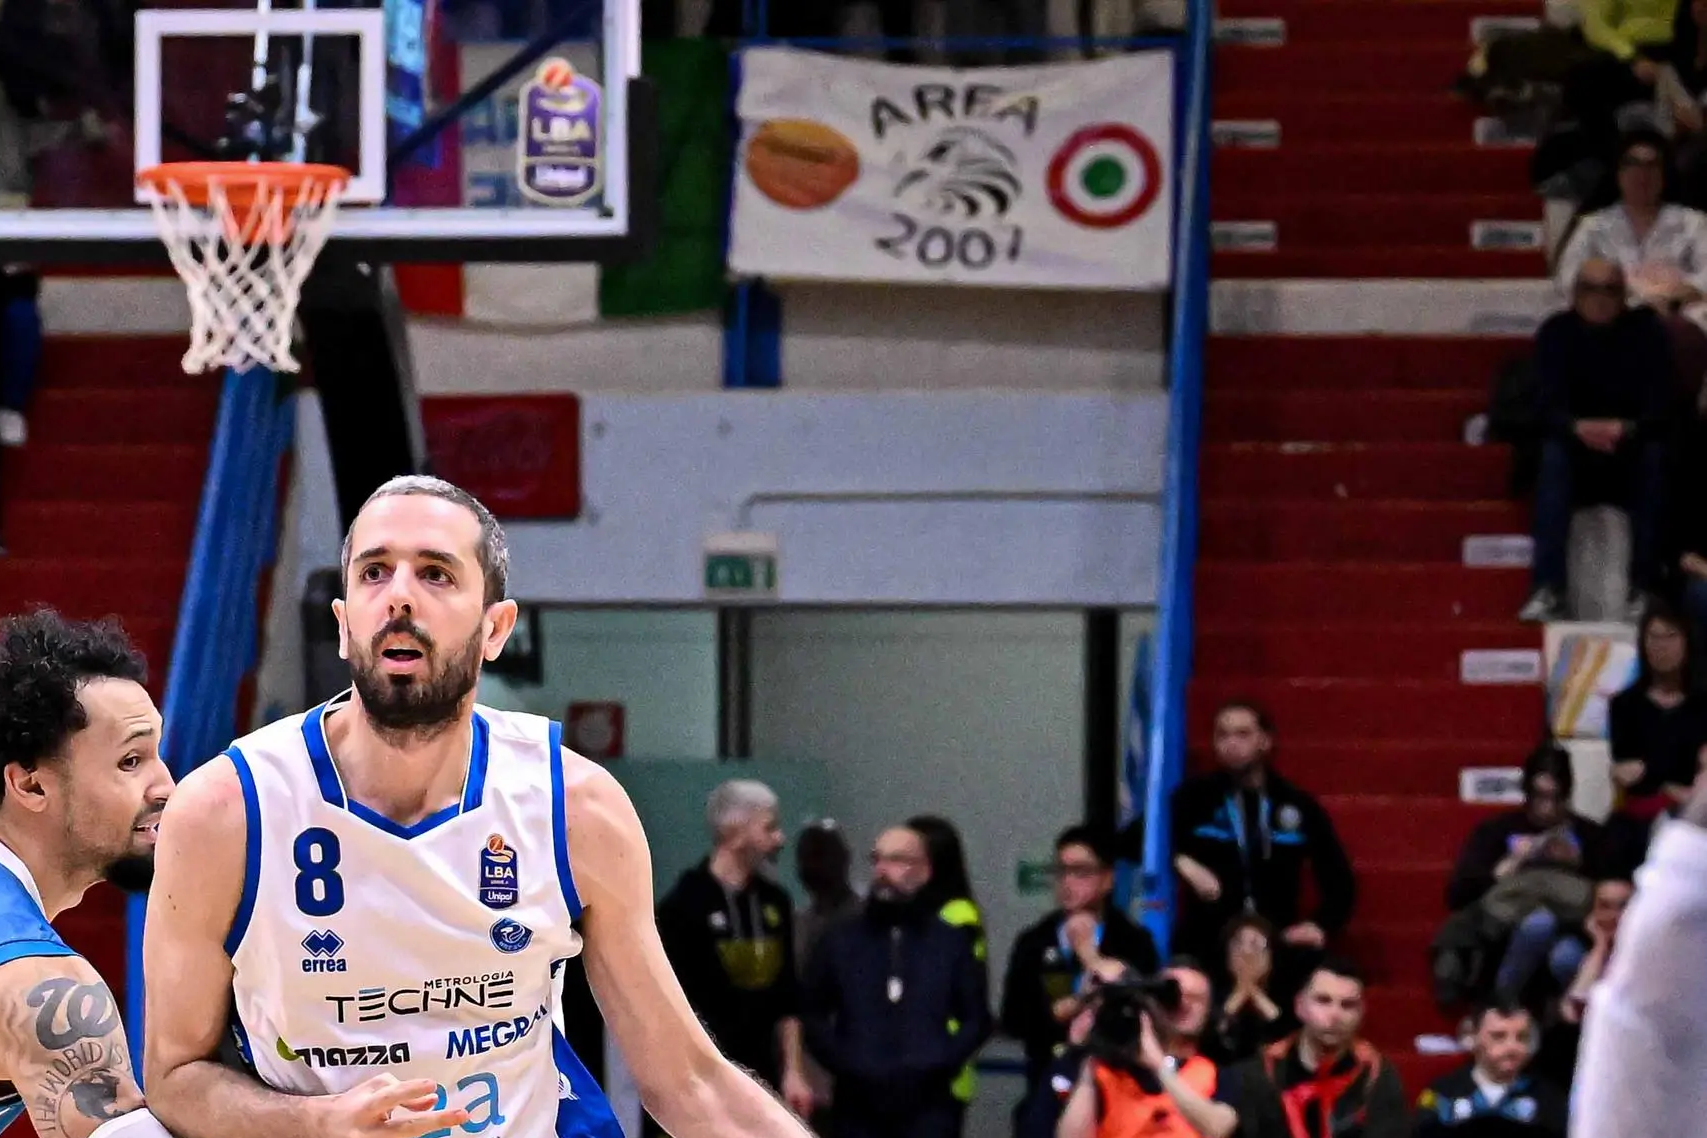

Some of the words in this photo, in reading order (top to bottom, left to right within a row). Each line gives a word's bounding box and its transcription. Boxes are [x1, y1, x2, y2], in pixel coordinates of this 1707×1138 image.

[871, 82, 1040, 138] AREA
[873, 212, 1023, 270] 2001
[293, 827, 344, 917] 8
[485, 865, 514, 880] LBA
[487, 890, 513, 903] Unipol
[424, 970, 514, 990] METROLOGIA
